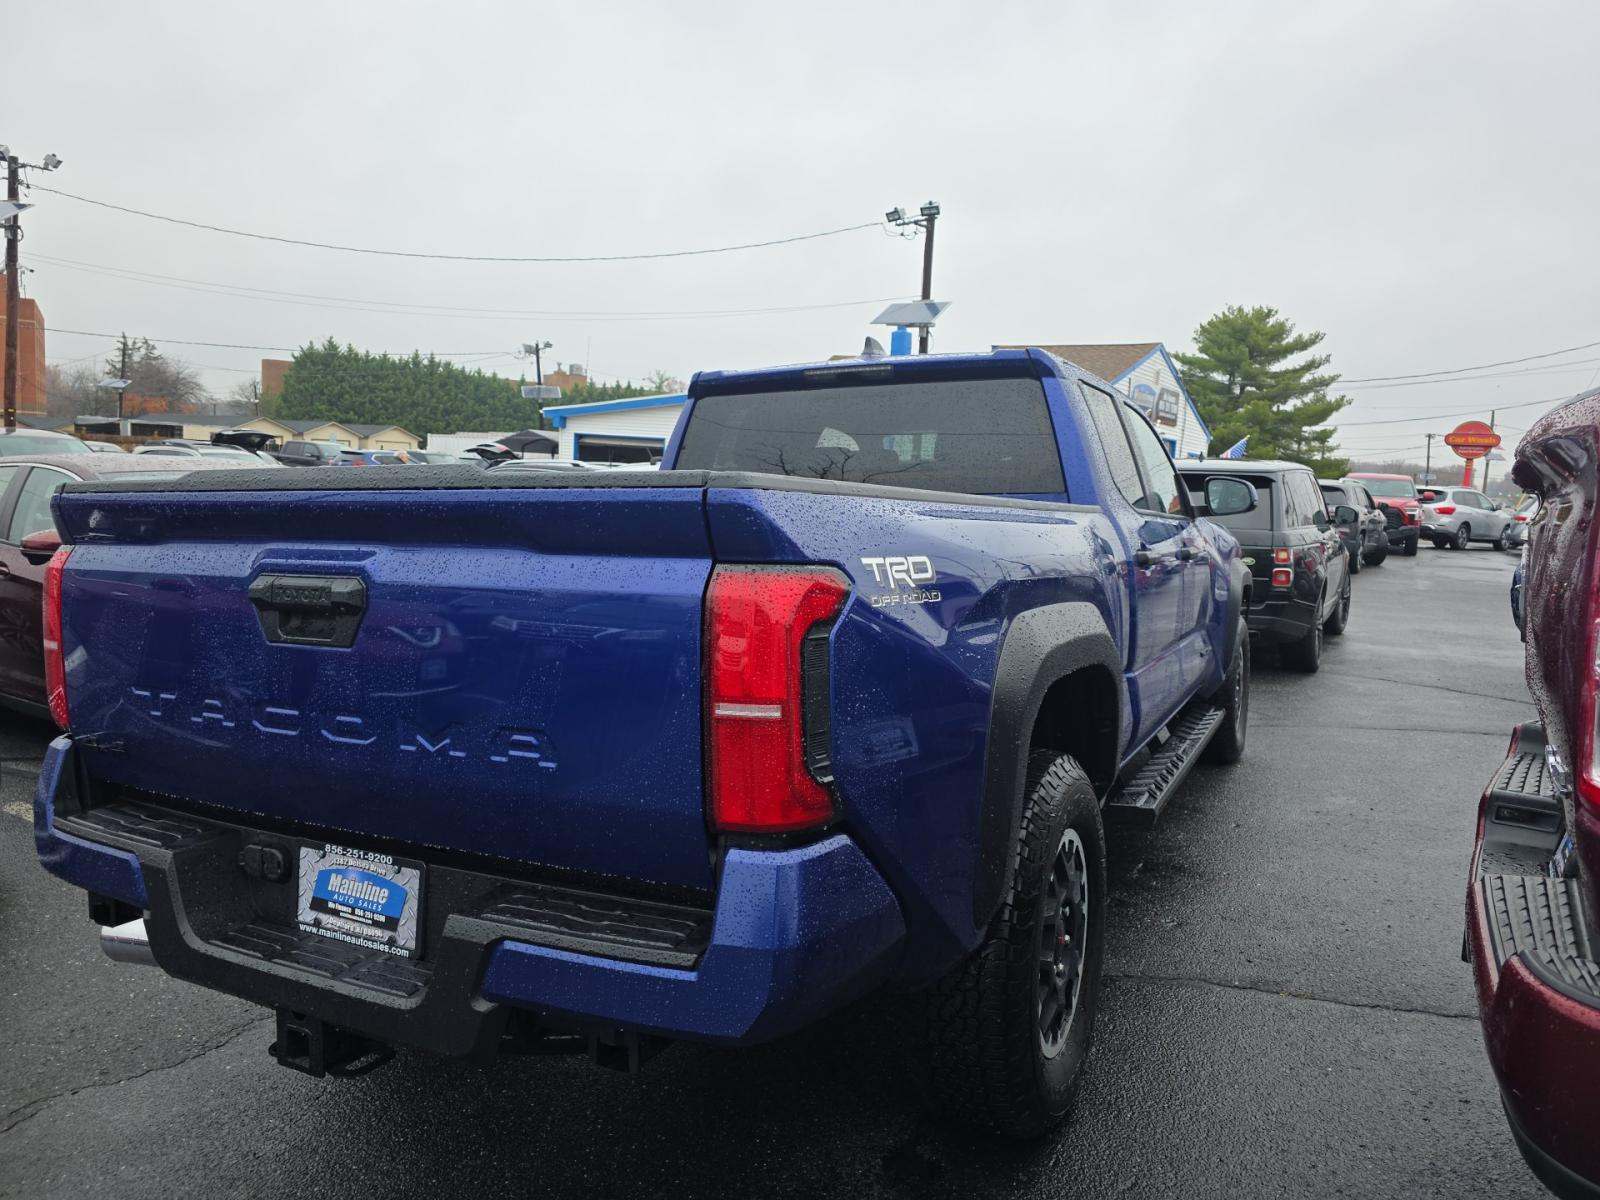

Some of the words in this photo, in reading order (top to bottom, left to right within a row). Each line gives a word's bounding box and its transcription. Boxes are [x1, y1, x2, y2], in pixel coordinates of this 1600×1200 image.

[860, 556, 935, 589] TRD
[274, 588, 332, 604] TOYOTA
[871, 594, 899, 607] OFF
[901, 589, 941, 605] ROAD
[129, 684, 558, 769] TACOMA
[325, 844, 393, 865] 856-251-9200
[328, 872, 389, 904] Mainline
[333, 893, 354, 904] AUTO
[358, 899, 382, 912] SALES
[299, 923, 409, 957] www.mainlineautosales.com
